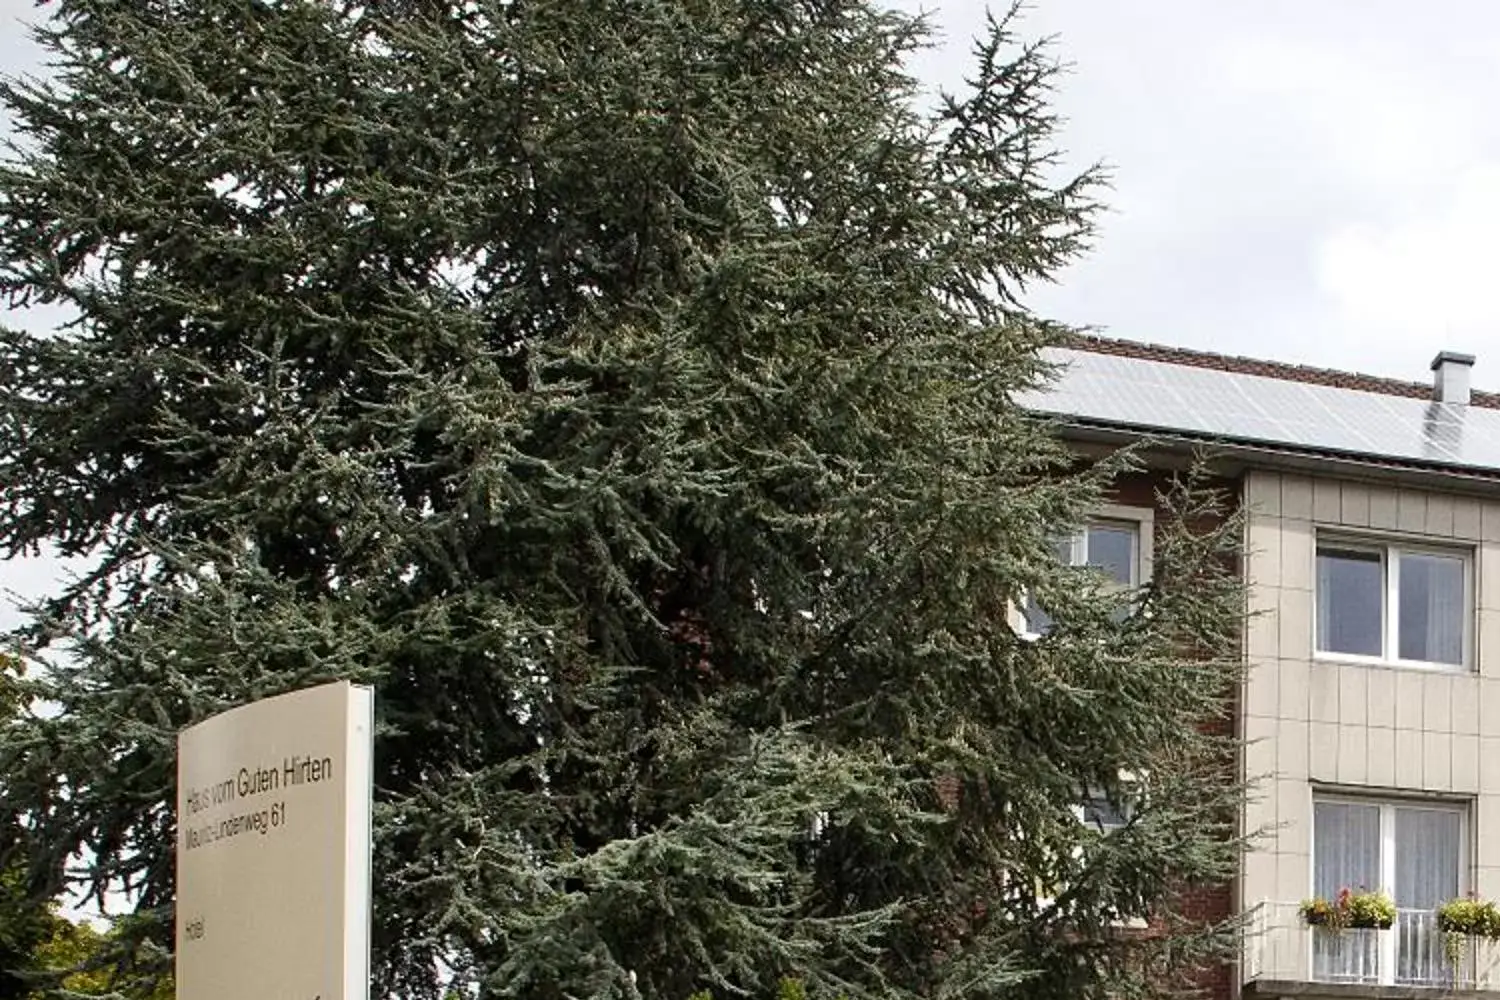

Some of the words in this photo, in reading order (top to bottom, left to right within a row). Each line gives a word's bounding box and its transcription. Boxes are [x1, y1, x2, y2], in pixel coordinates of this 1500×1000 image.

[212, 779, 235, 803] vom
[238, 767, 279, 798] Guten
[283, 755, 332, 787] Hirten
[271, 801, 286, 827] 61
